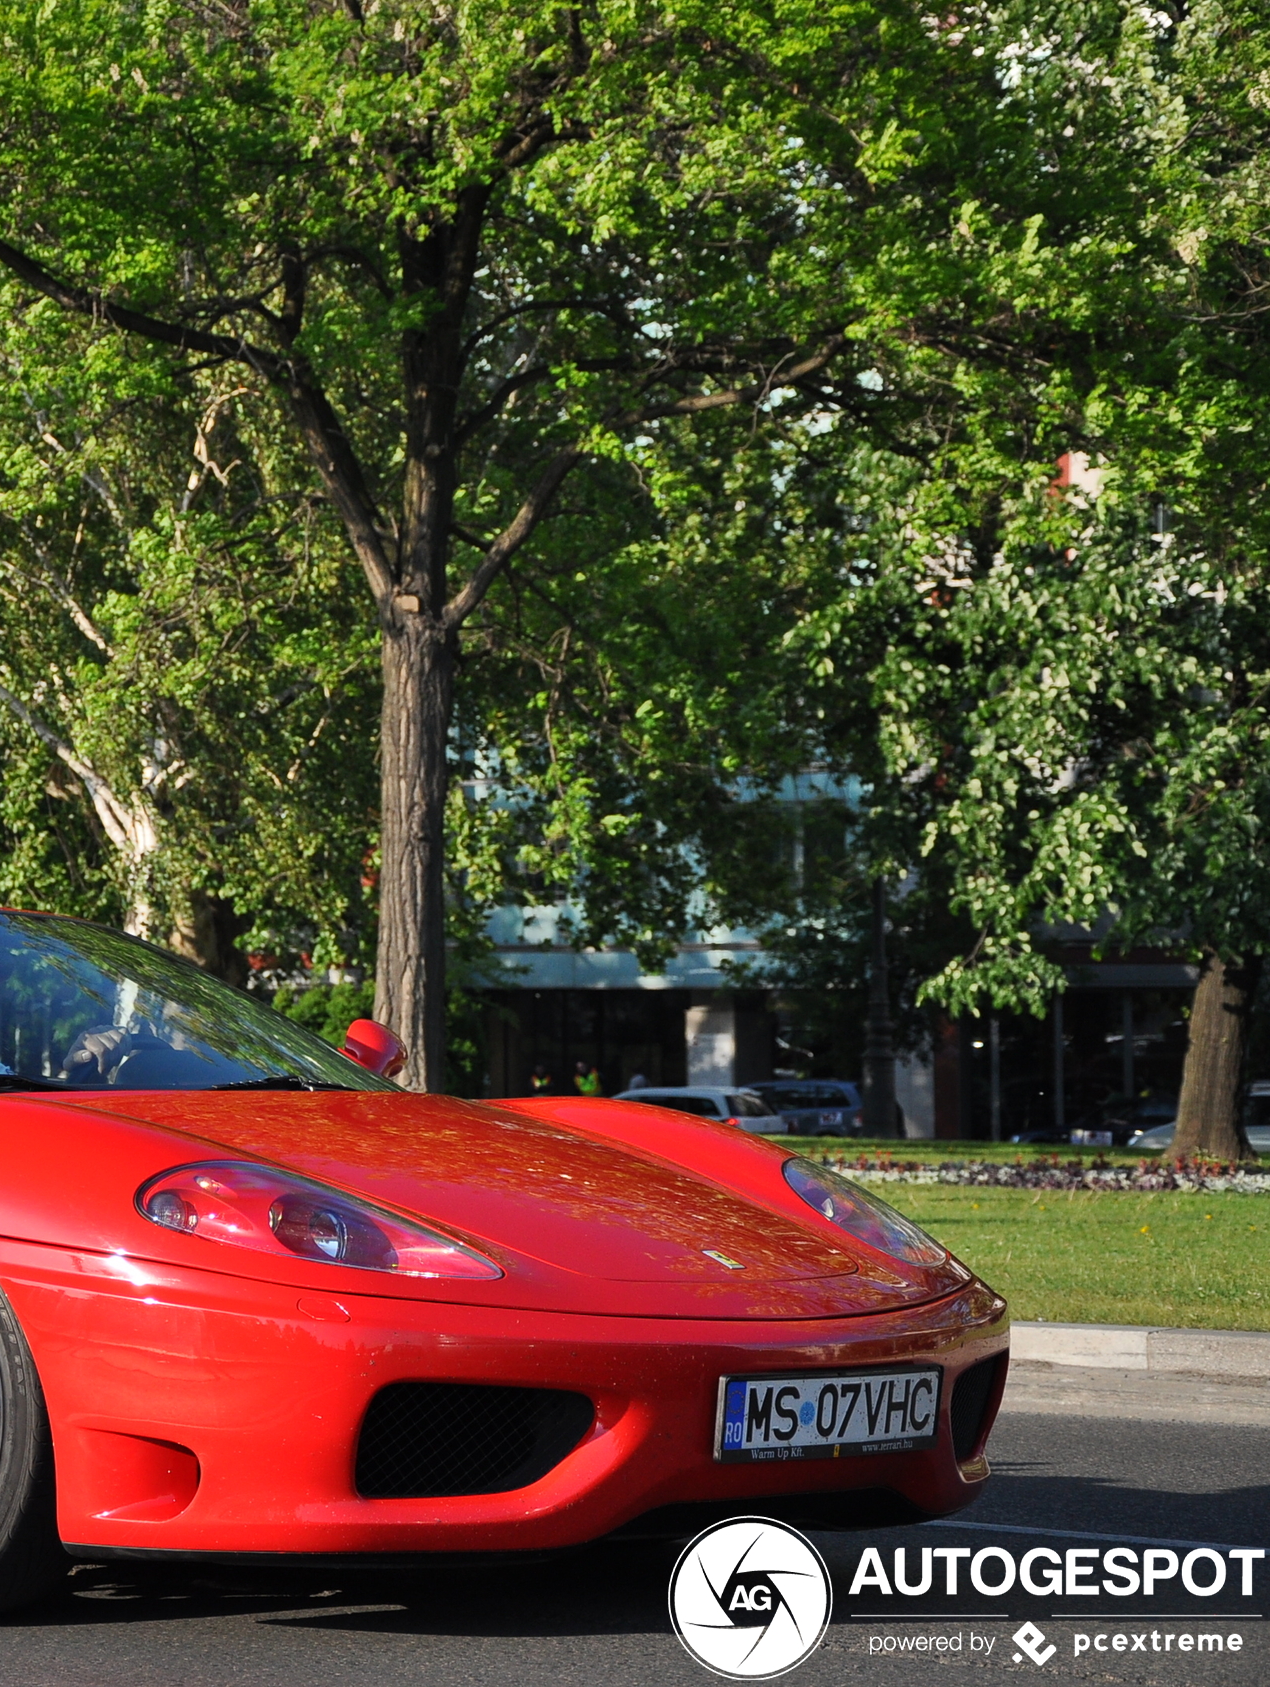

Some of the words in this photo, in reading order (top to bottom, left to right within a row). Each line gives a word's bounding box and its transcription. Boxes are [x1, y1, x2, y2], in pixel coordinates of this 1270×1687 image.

[746, 1386, 800, 1442] MS
[816, 1378, 933, 1438] 07VHC
[725, 1422, 742, 1443] RO
[751, 1449, 775, 1460] Warm
[777, 1449, 789, 1460] Up
